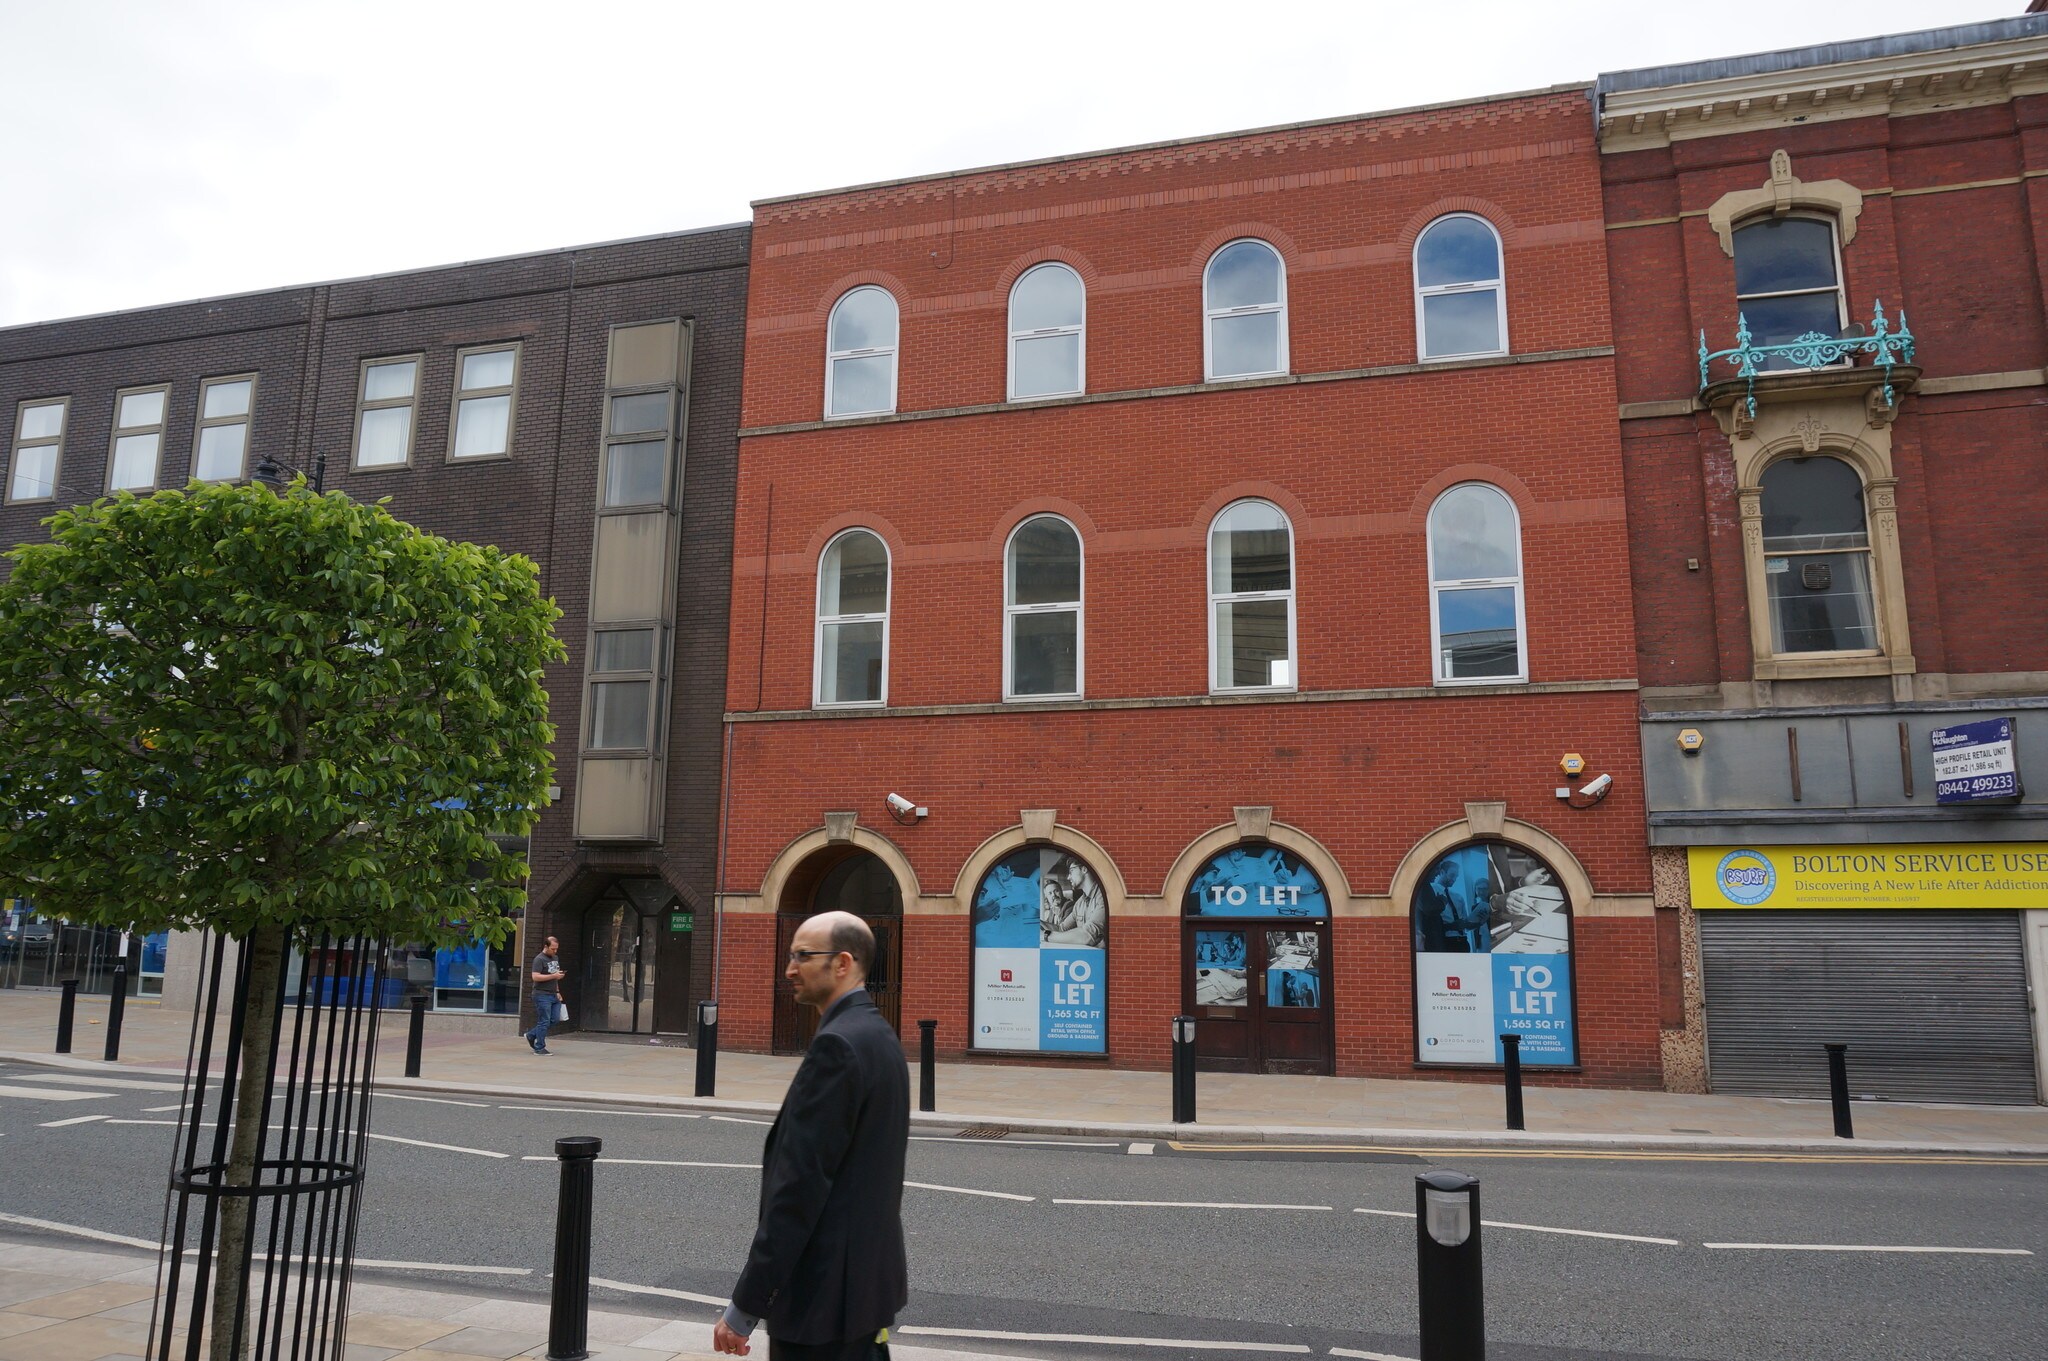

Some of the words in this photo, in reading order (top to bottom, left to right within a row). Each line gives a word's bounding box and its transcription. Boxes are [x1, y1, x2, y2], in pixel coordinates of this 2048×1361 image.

[1932, 735, 1968, 745] McNaughton
[1935, 756, 1948, 766] HIGH
[1948, 752, 1971, 763] PROFILE
[1972, 749, 1992, 759] RETAIL
[1993, 746, 2007, 756] UNIT
[1942, 766, 1958, 775] 182.87
[1960, 764, 1968, 772] m2
[1969, 762, 1986, 773] (1,986
[1987, 762, 1994, 770] sq
[1938, 780, 1970, 796] 08442
[1971, 775, 2013, 792] 499233
[1792, 855, 1887, 873] BOLTON
[1894, 854, 1996, 873] SERVICE
[2003, 854, 2048, 873] USE
[1725, 867, 1767, 886] BSURF
[1795, 880, 1870, 893] Discovering
[1873, 880, 1882, 890] A
[1886, 880, 1915, 890] New
[1919, 879, 1943, 890] Life
[1946, 879, 1980, 890] After
[1983, 879, 2048, 890] Addiction
[1211, 886, 1247, 906] TO
[1259, 886, 1301, 906] LET
[1054, 960, 1092, 982] TO
[1509, 965, 1553, 990] TO
[1053, 983, 1095, 1005] LET
[1509, 991, 1557, 1014] LET
[1047, 1009, 1072, 1019] 1,565
[1074, 1010, 1088, 1019] SQ
[1090, 1010, 1101, 1019] FT
[1503, 1019, 1532, 1029] 1,565
[1535, 1020, 1551, 1030] SQ
[1554, 1020, 1566, 1030] FT
